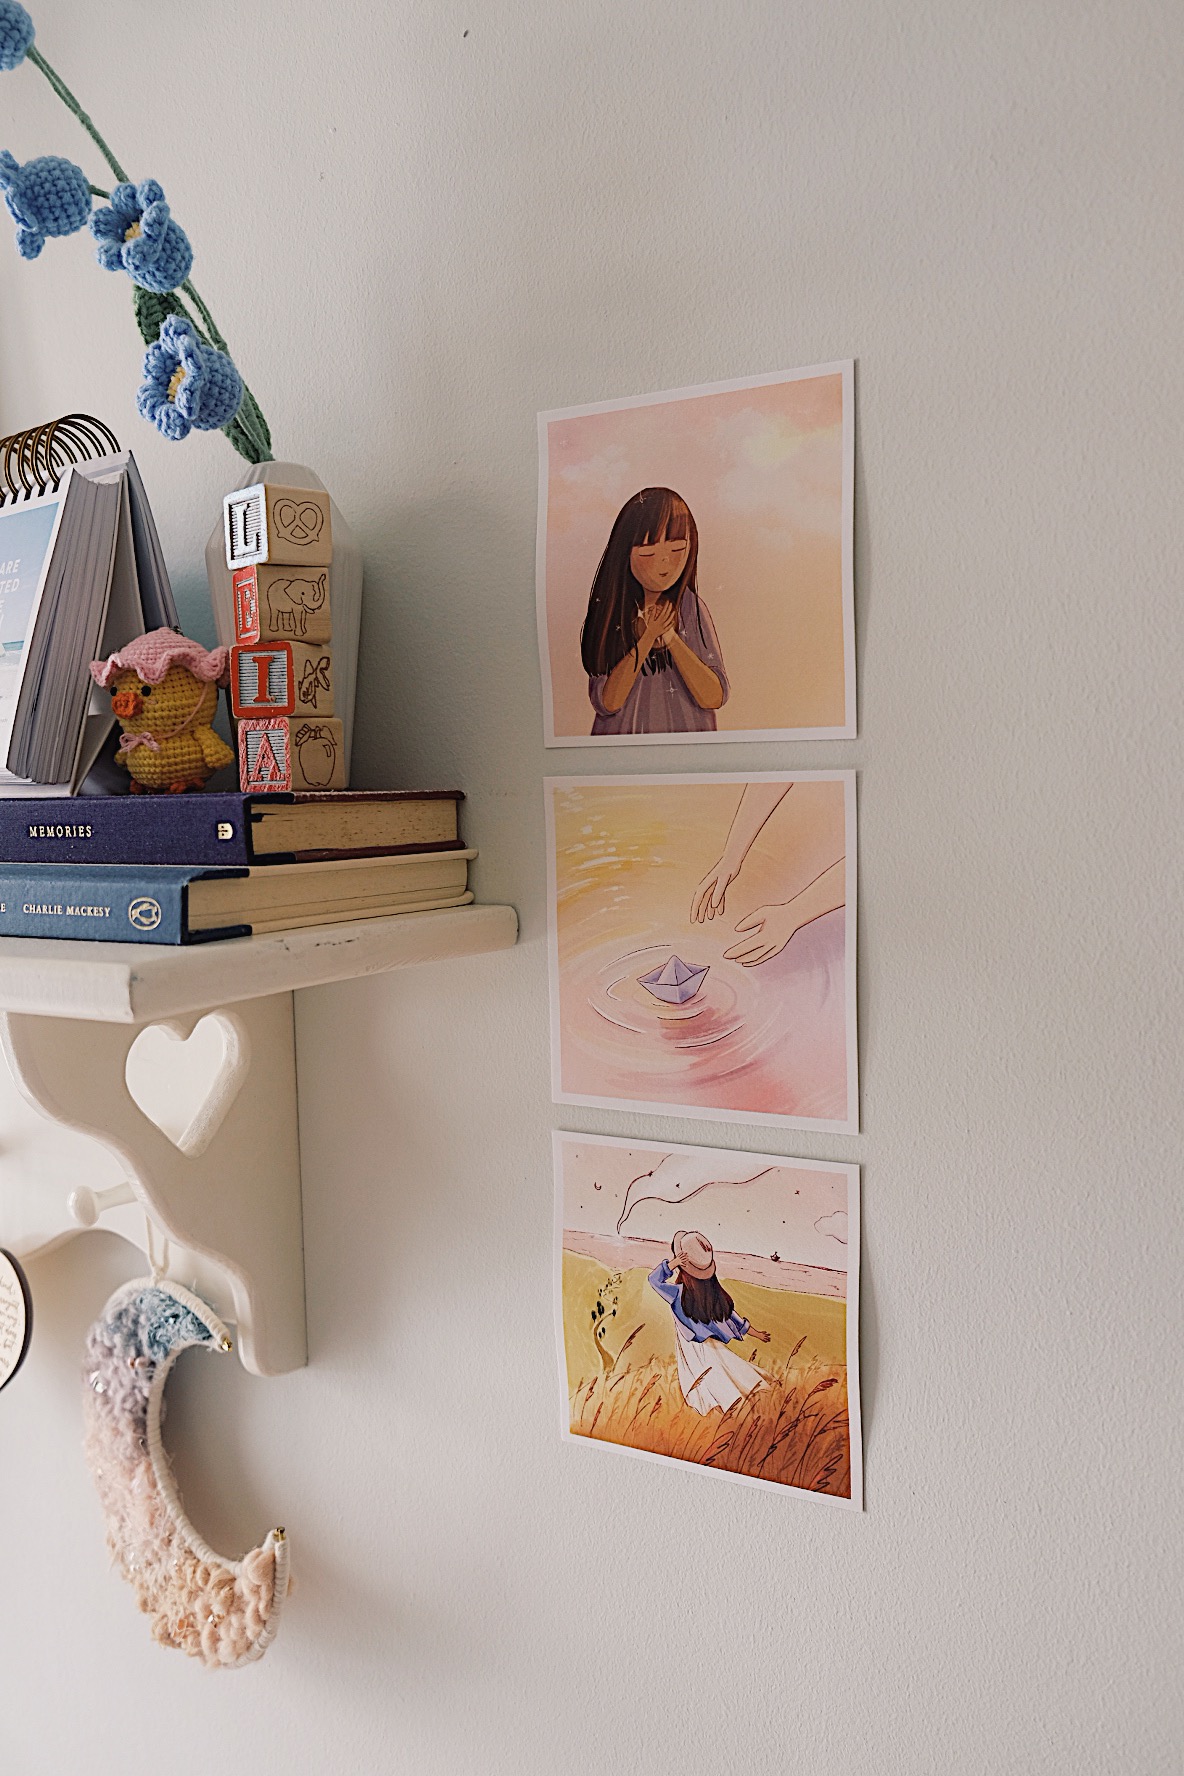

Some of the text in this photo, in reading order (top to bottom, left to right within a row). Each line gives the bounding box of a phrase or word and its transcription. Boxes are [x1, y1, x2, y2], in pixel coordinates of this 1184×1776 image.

[232, 503, 259, 556] L
[0, 559, 20, 575] ARE
[247, 732, 288, 782] A
[29, 825, 92, 838] MEMORIES
[23, 903, 63, 915] CHARLIE
[66, 905, 110, 917] MACKESY
